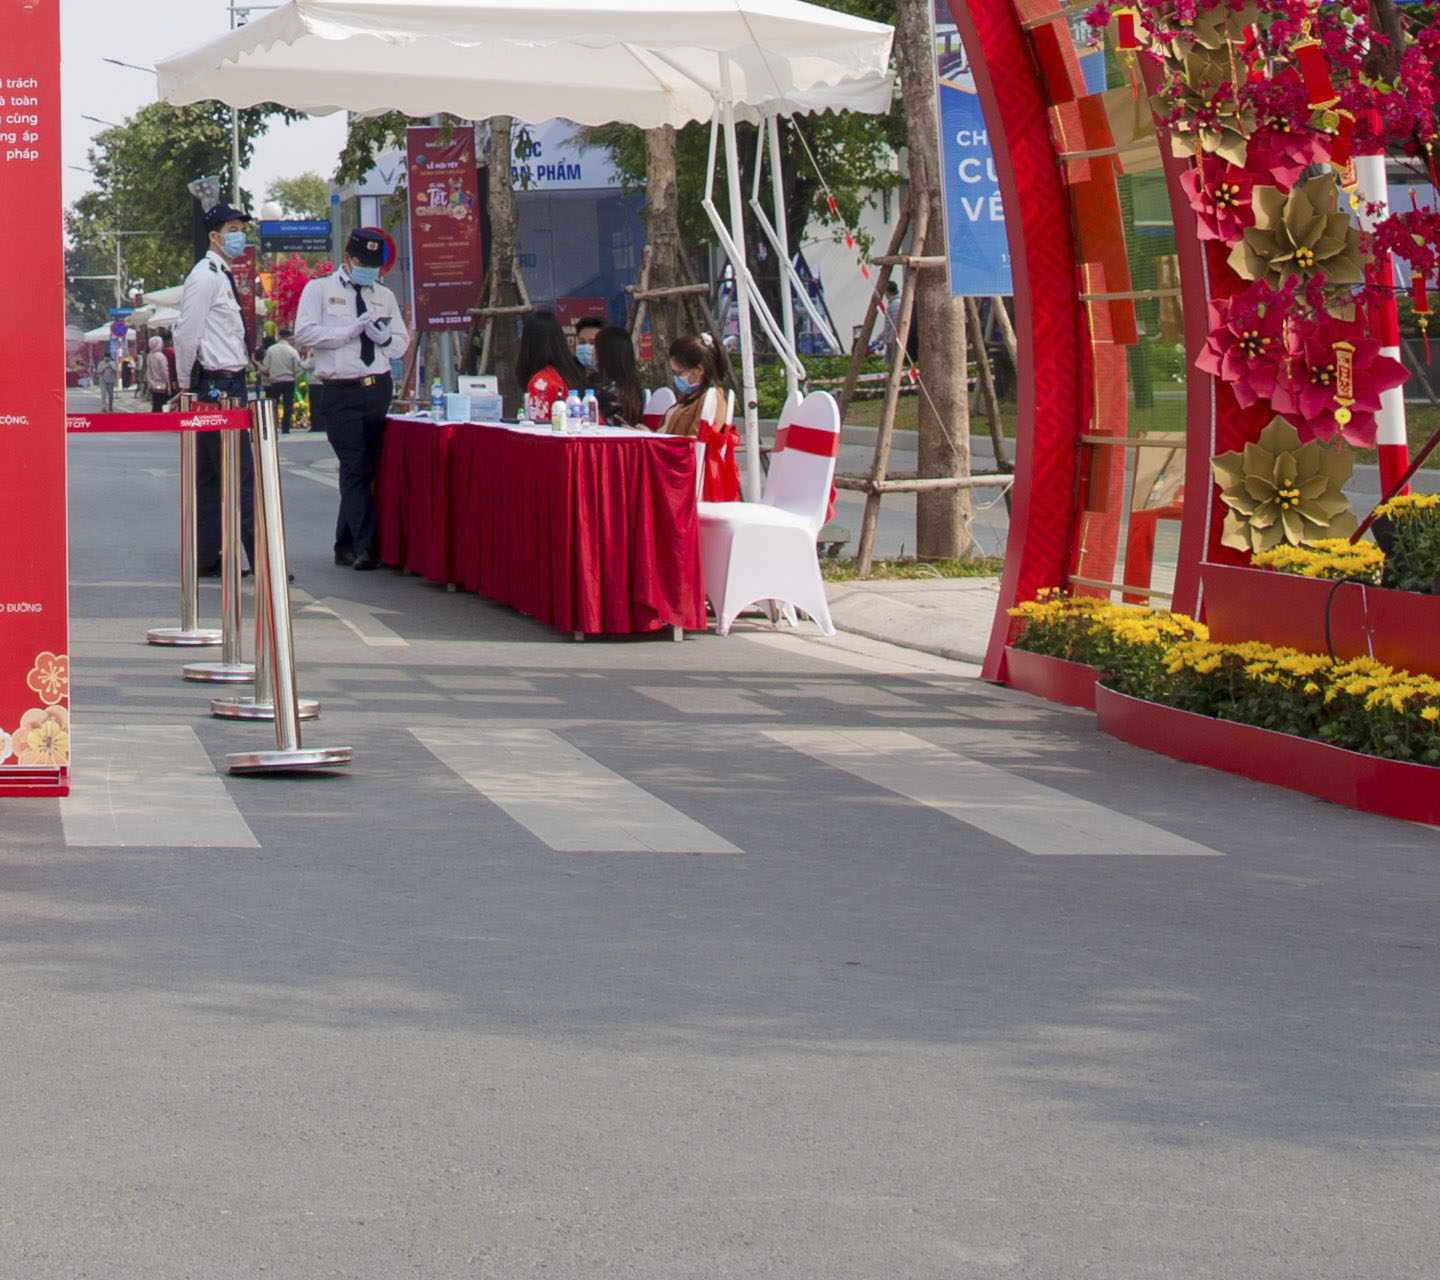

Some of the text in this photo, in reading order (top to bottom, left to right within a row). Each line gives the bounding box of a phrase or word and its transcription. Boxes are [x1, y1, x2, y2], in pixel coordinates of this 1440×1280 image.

[6, 78, 37, 88] trách
[10, 95, 38, 106] toàn
[23, 130, 38, 144] áp
[7, 148, 39, 161] pháp
[537, 156, 582, 181] PHẨM
